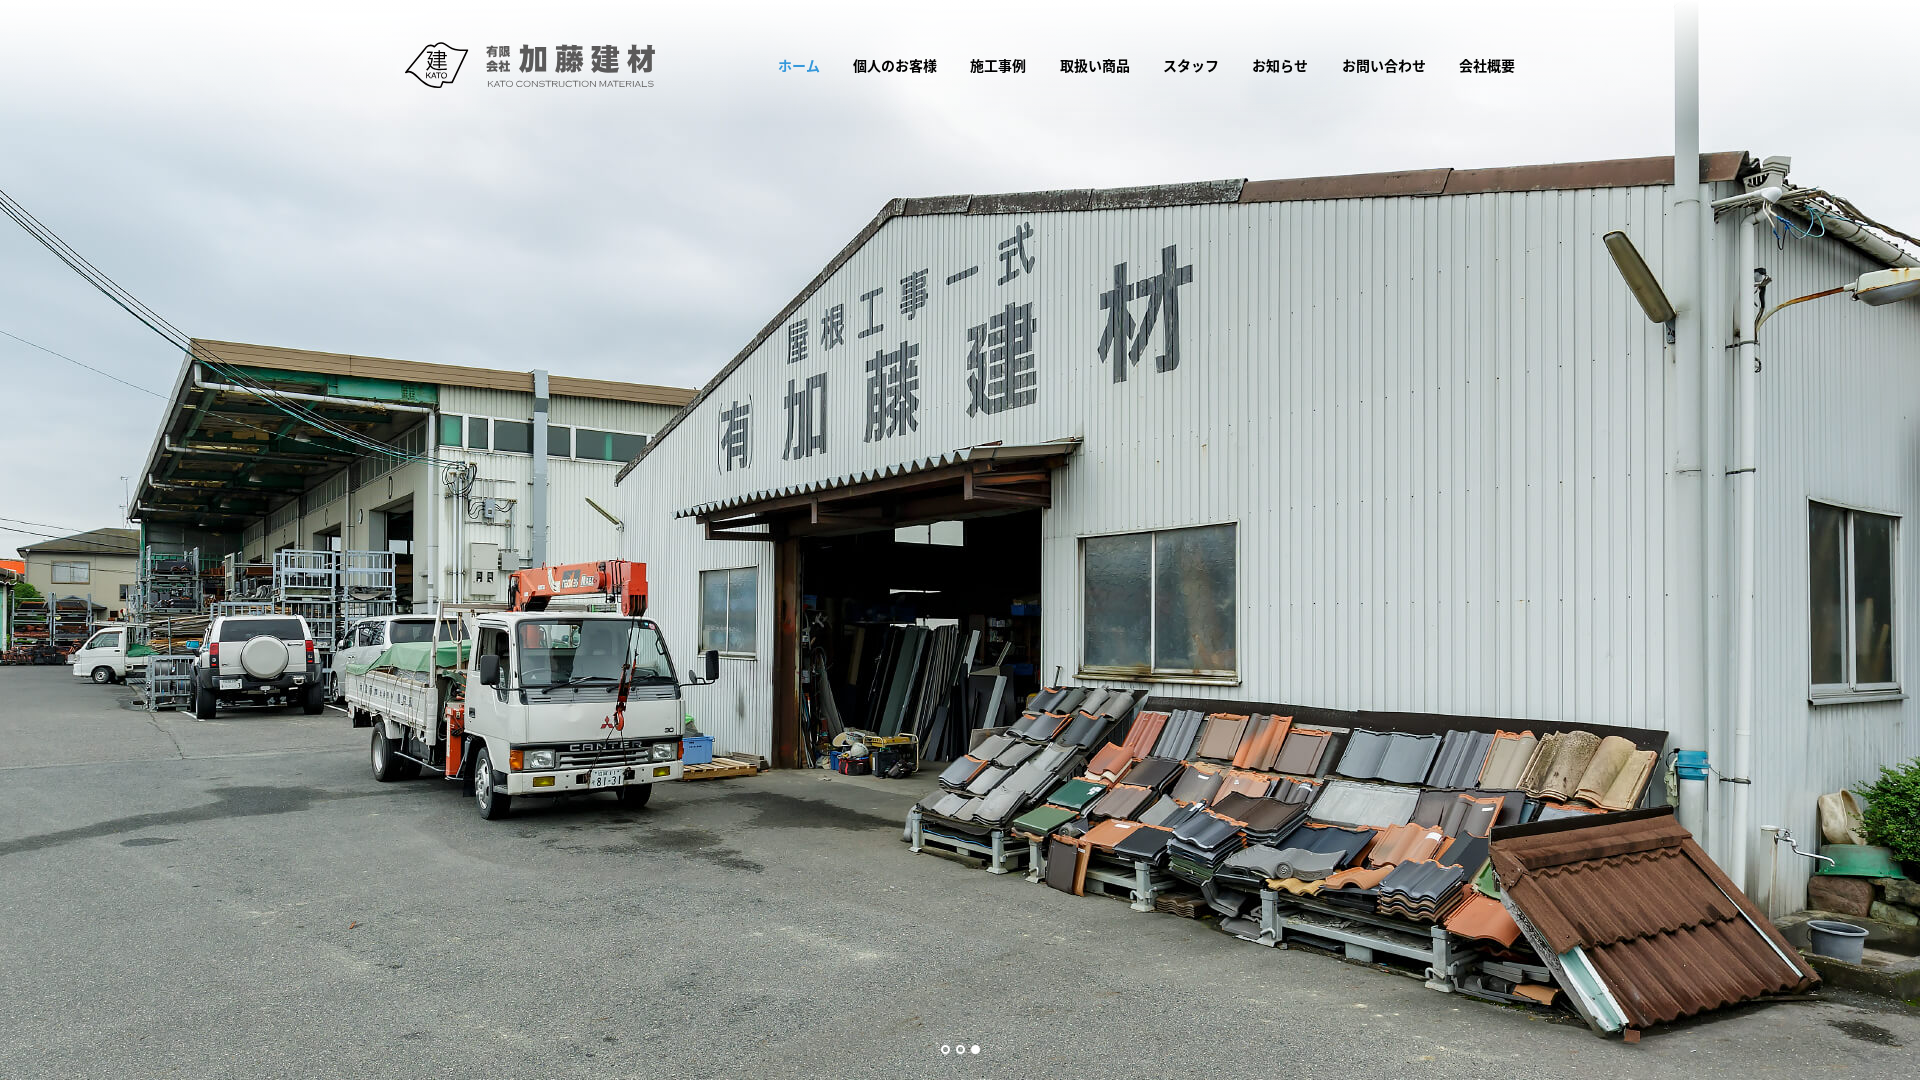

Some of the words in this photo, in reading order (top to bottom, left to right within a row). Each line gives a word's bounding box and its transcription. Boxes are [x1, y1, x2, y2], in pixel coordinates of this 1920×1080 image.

[787, 221, 1036, 365] 屋根工事一式
[569, 741, 642, 752] CANTER
